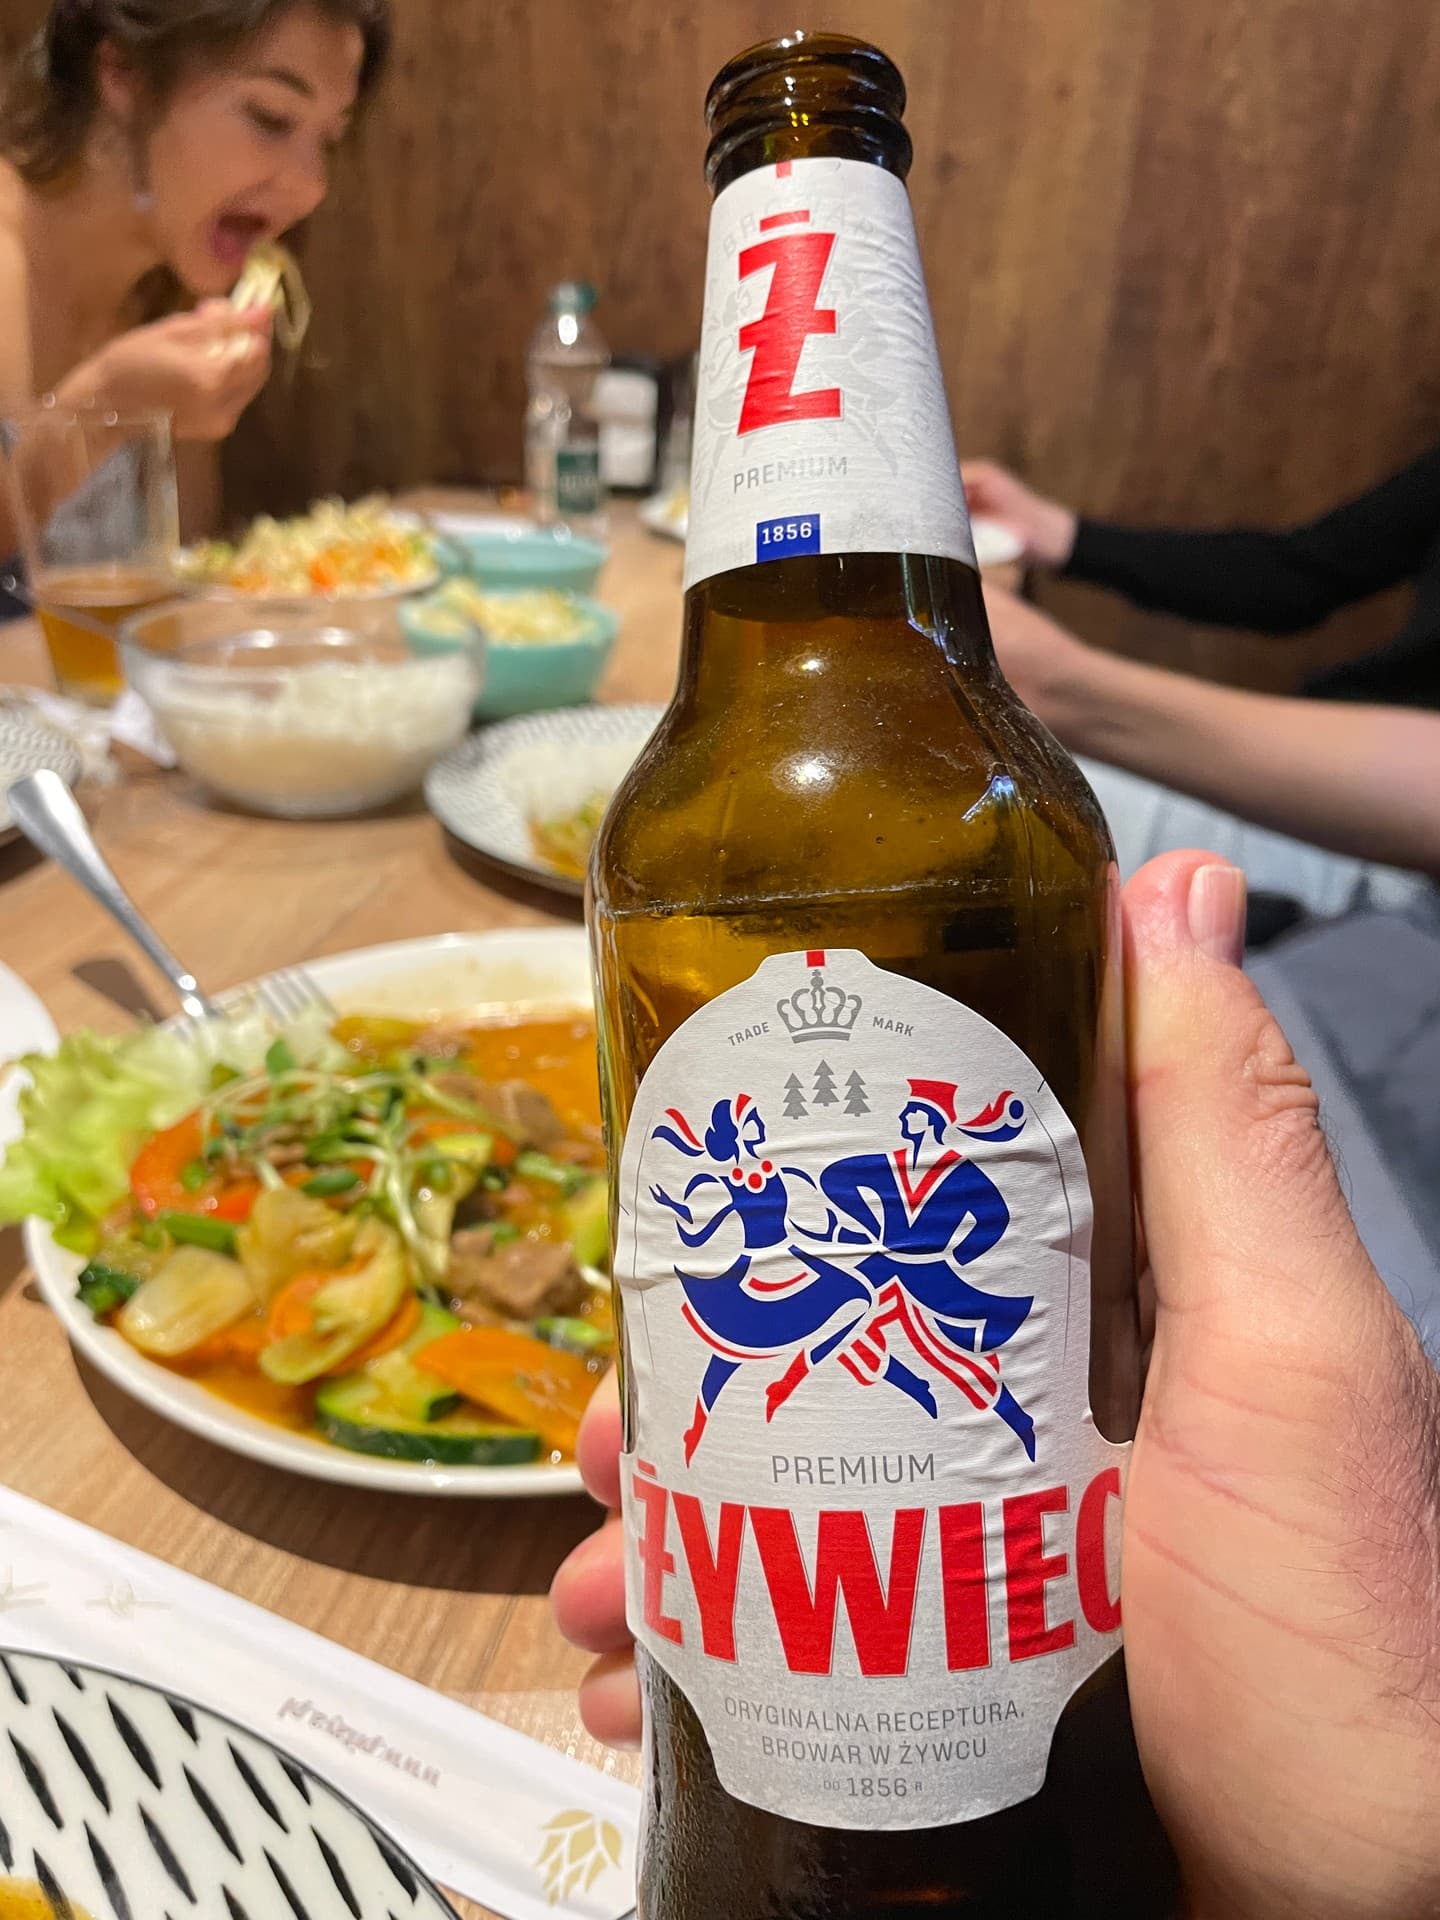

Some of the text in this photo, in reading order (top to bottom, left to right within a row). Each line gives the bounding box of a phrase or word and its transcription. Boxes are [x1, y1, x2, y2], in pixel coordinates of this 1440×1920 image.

[733, 456, 848, 494] PREMIUM
[761, 522, 812, 545] 1856
[728, 1016, 914, 1046] TRADE MARK
[772, 1453, 936, 1485] PREMIUM
[724, 1697, 869, 1732] ORYGINALNA
[762, 1736, 987, 1765] BROWAR W ŻYWCU
[847, 1777, 907, 1797] 1856
